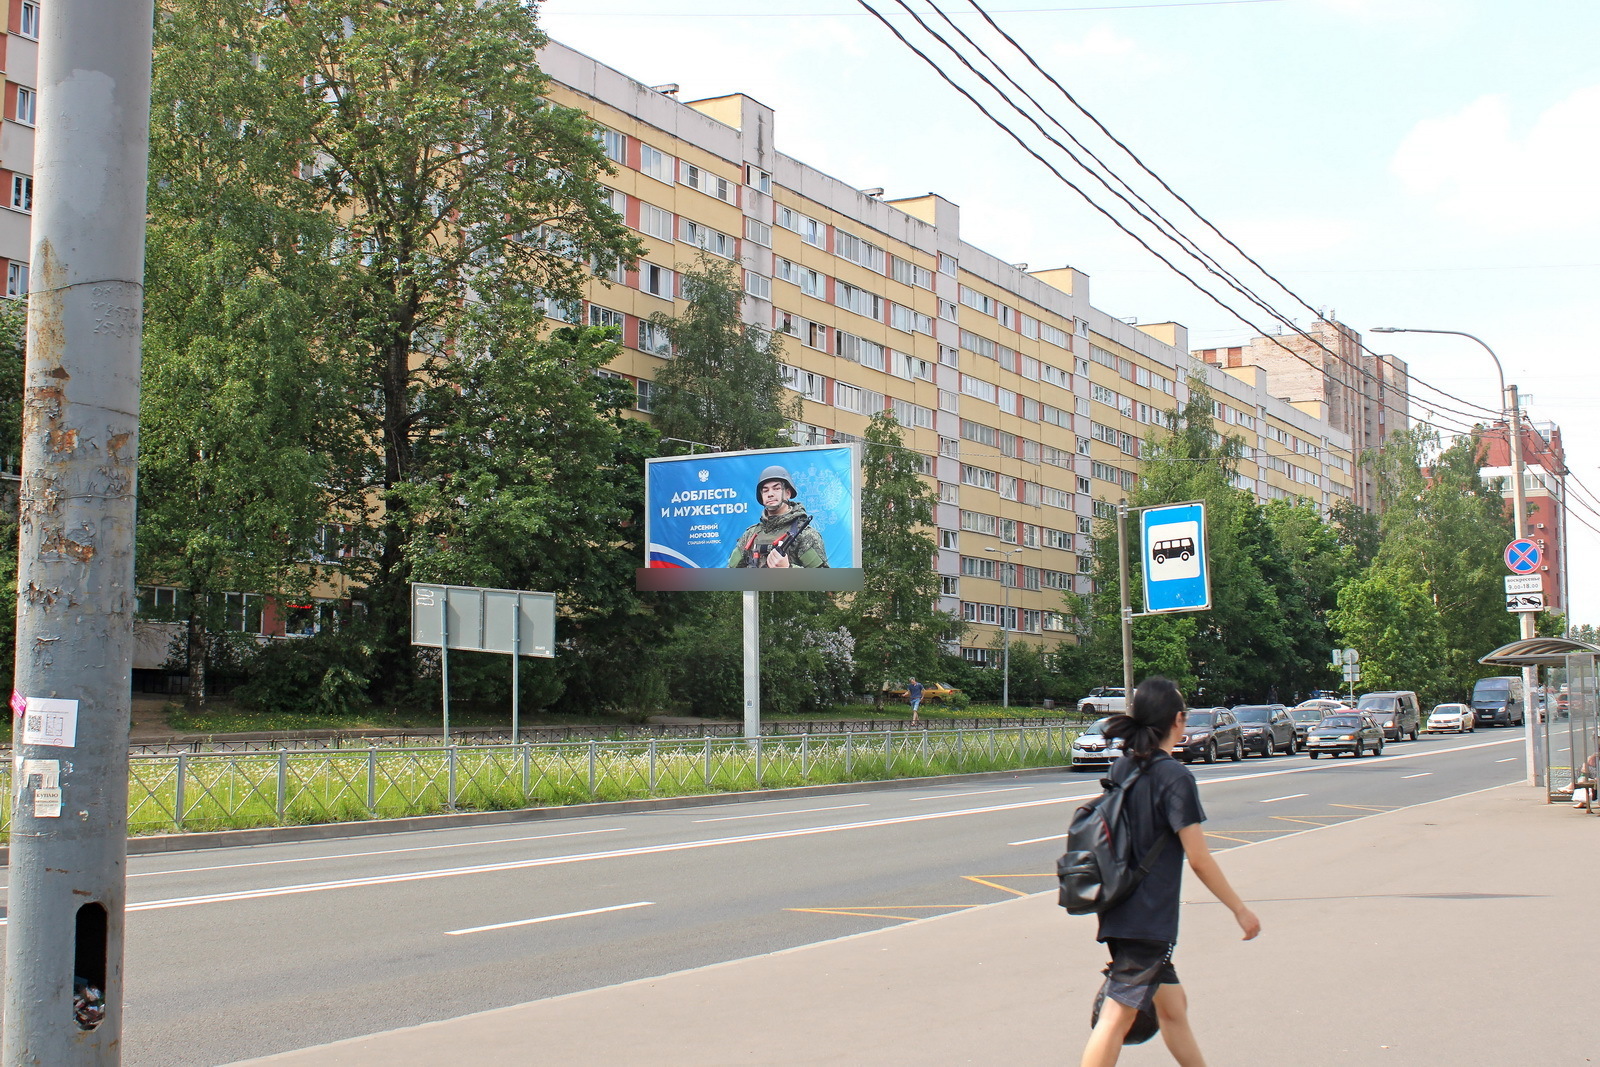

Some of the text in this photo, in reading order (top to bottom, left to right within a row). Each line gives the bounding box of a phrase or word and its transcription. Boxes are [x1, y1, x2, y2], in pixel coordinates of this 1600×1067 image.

[671, 488, 737, 504] ДОБЛЕСТЬ
[661, 503, 748, 518] И МУЖЕСТВО!
[690, 523, 718, 531] АРСЕНИЙ
